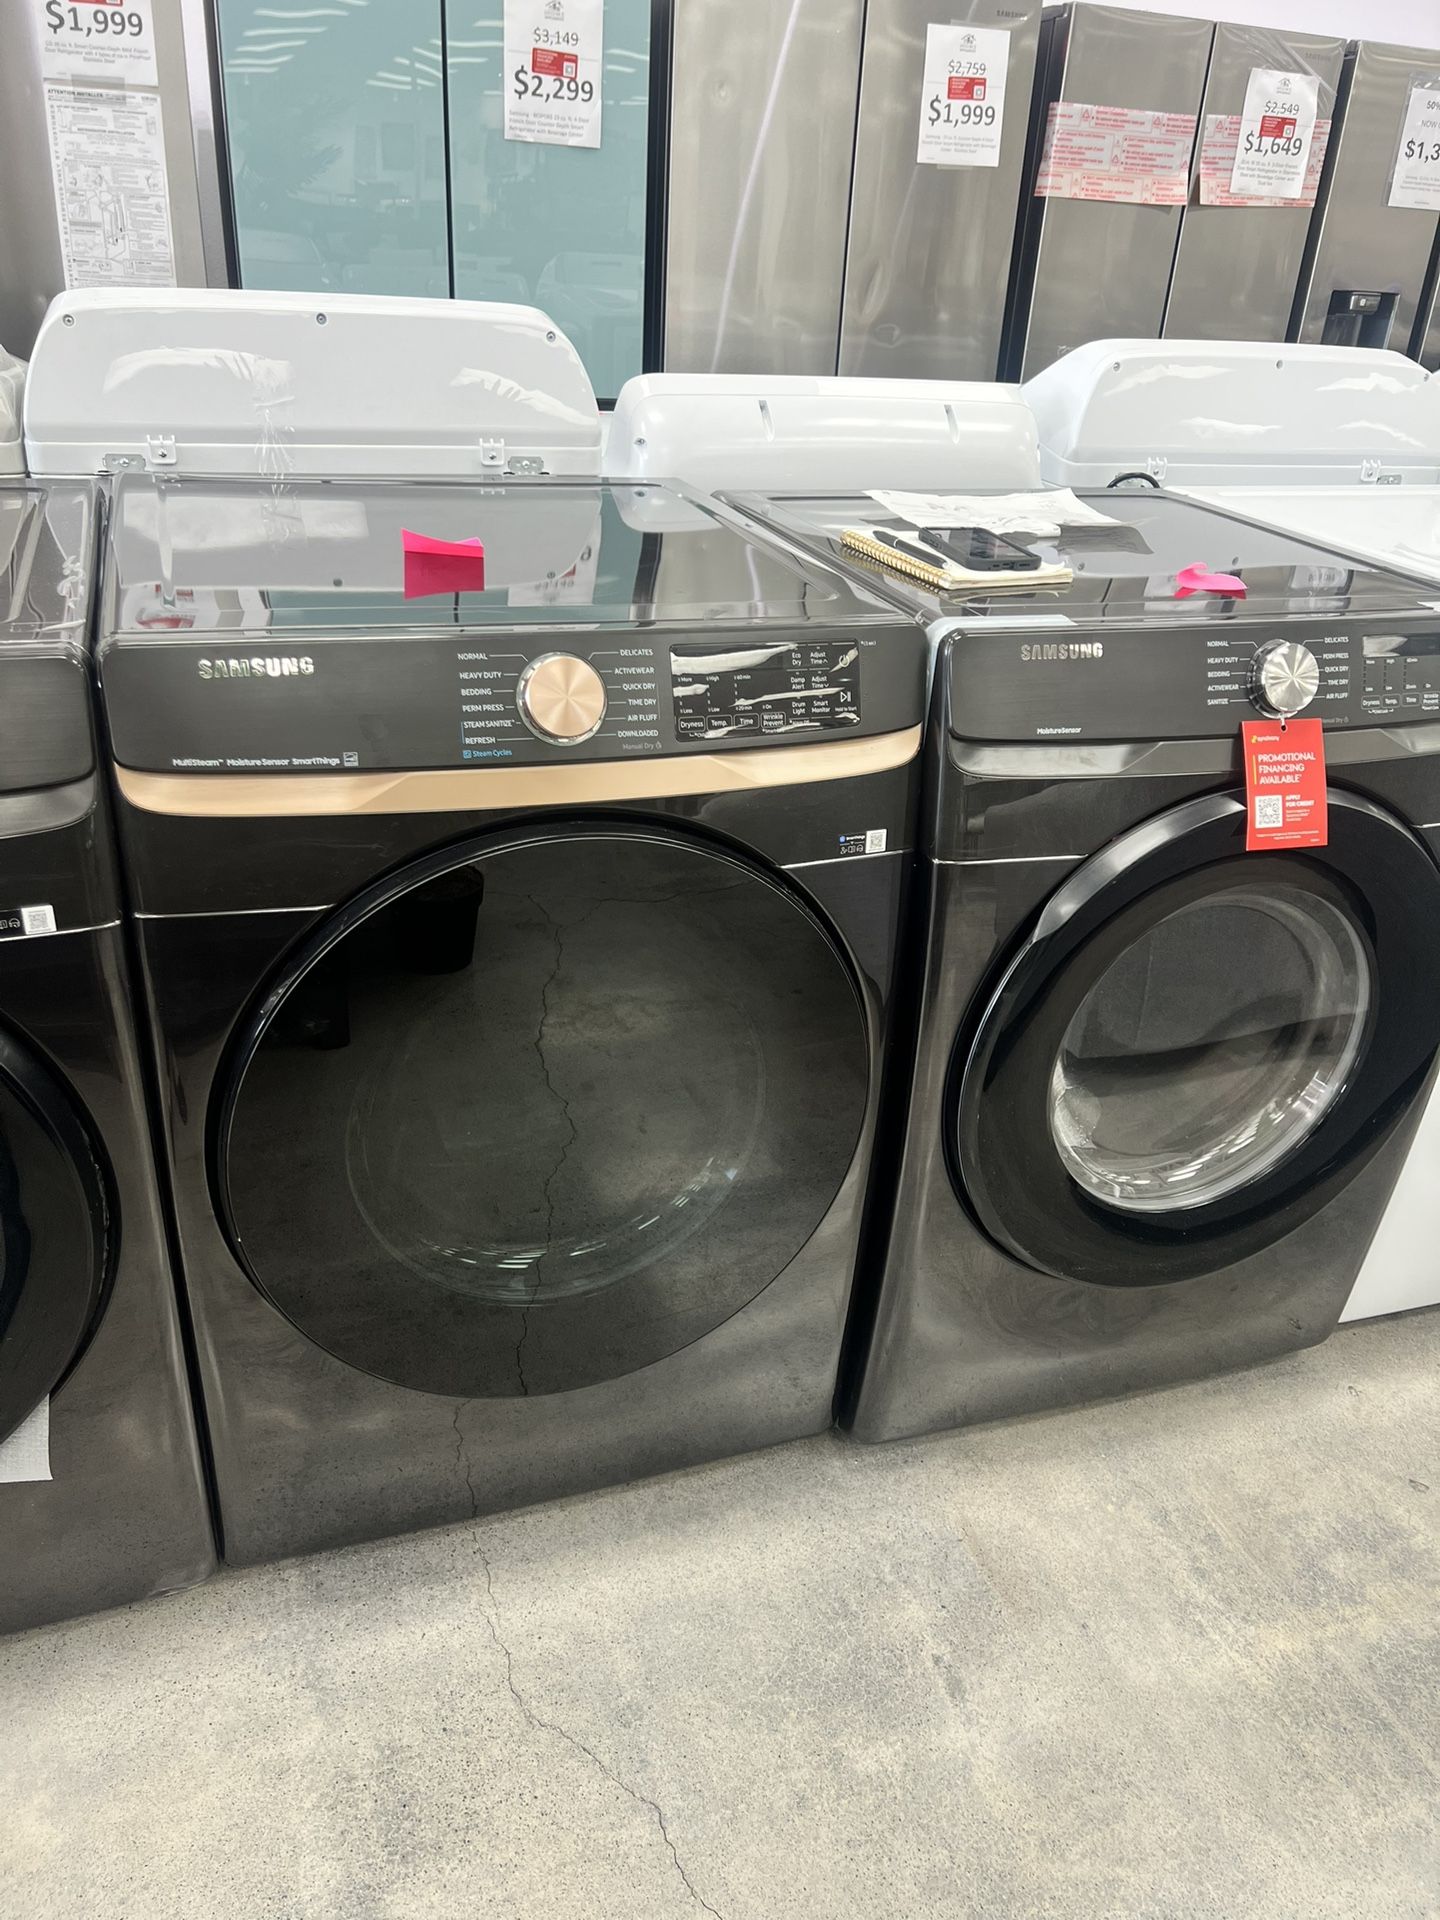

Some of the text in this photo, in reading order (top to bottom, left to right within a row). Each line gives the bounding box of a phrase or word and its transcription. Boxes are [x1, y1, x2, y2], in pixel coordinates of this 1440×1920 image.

[46, 0, 143, 37] $1,999
[534, 26, 580, 46] $3,149
[948, 59, 986, 76] $2,759
[514, 65, 594, 103] $2,299
[928, 94, 996, 128] $1,999
[1264, 100, 1300, 116] $2,549
[1244, 130, 1303, 156] $1,649
[1324, 636, 1349, 644] DELICATES
[620, 648, 654, 656] DELICATES
[1021, 642, 1104, 661] SAMSUNG
[1225, 656, 1239, 664] DUTY
[198, 656, 315, 679] SAMSUNG
[614, 666, 655, 675] ACTIVEWEAR
[459, 671, 502, 680] HEAVY DUTY
[1208, 670, 1230, 678] BEDDING
[790, 676, 806, 684] Damp
[622, 682, 656, 691] QUICK DRY
[460, 688, 492, 696] BEDDING
[628, 698, 657, 706] TIME DRY
[1207, 698, 1229, 706] SANITIZE
[462, 704, 504, 712] PERM PRESS
[792, 708, 806, 716] Light
[628, 714, 638, 722] AIR
[463, 720, 485, 729] STEAM
[680, 720, 704, 730] Dryness
[710, 719, 728, 727] Temp.
[618, 730, 659, 738] DOWNLOADED
[464, 736, 496, 745] REFRESH
[644, 742, 654, 750] Dry
[472, 748, 513, 758] Steam Cycles
[1258, 752, 1316, 763] PROMOTIONAL
[292, 756, 340, 767] SmartThings
[1258, 764, 1305, 774] FINANCING
[1286, 800, 1296, 808] FOR
